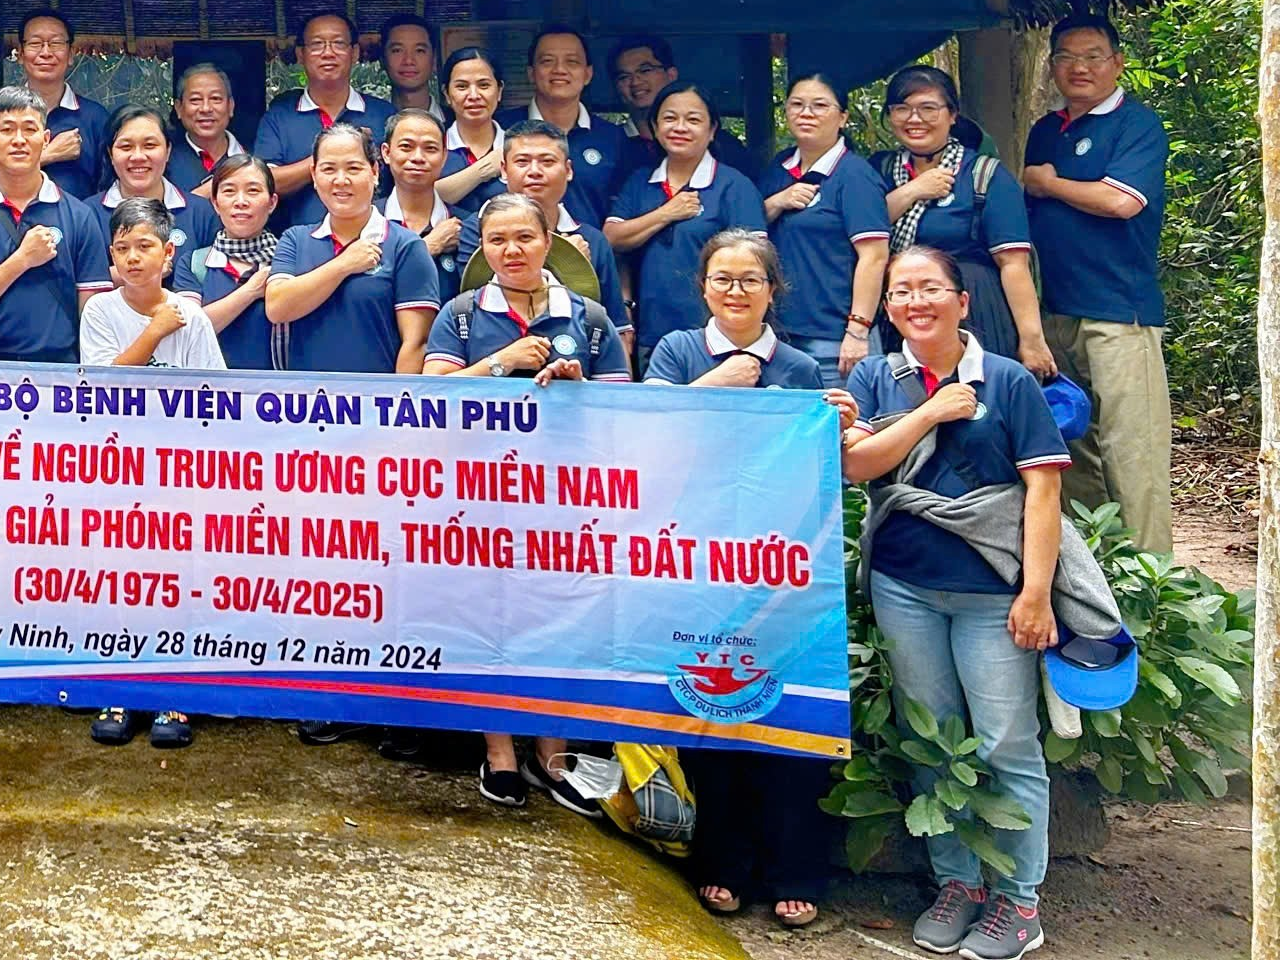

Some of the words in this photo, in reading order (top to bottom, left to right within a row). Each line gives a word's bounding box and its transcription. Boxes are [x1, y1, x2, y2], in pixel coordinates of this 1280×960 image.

[53, 380, 146, 422] BỆNH
[157, 384, 242, 427] VIỆN
[256, 388, 361, 432] QUẬN
[375, 391, 447, 429] TÂN
[462, 395, 538, 433] PHÚ
[32, 432, 144, 486] NGUỒN
[156, 448, 263, 490] TRUNG
[275, 449, 365, 495] ƯƠNG
[378, 457, 444, 507] CỤC
[456, 449, 545, 504] MIỀN
[557, 465, 639, 510] NAM
[6, 493, 69, 546] GIẢI
[81, 502, 193, 552] PHÓNG
[204, 502, 290, 556] MIỀN
[302, 517, 390, 567] NAM,
[401, 511, 514, 569] THỐNG
[526, 519, 617, 575] NHẤT
[628, 522, 696, 580] ĐẤT
[709, 534, 810, 587] NƯỚC
[14, 566, 180, 608] (30/4/1975
[213, 575, 384, 623] 30/4/2025)
[9, 622, 74, 653] Ninh,
[83, 626, 147, 658] ngày
[155, 630, 185, 655] 28
[193, 633, 267, 665] tháng
[277, 637, 305, 662] 12
[313, 641, 369, 667] năm
[380, 644, 442, 671] 2024
[673, 631, 695, 641] Đơn
[699, 635, 709, 645] vị
[712, 632, 723, 643] tổ
[676, 680, 696, 702] CTCP
[735, 698, 764, 718] THANH
